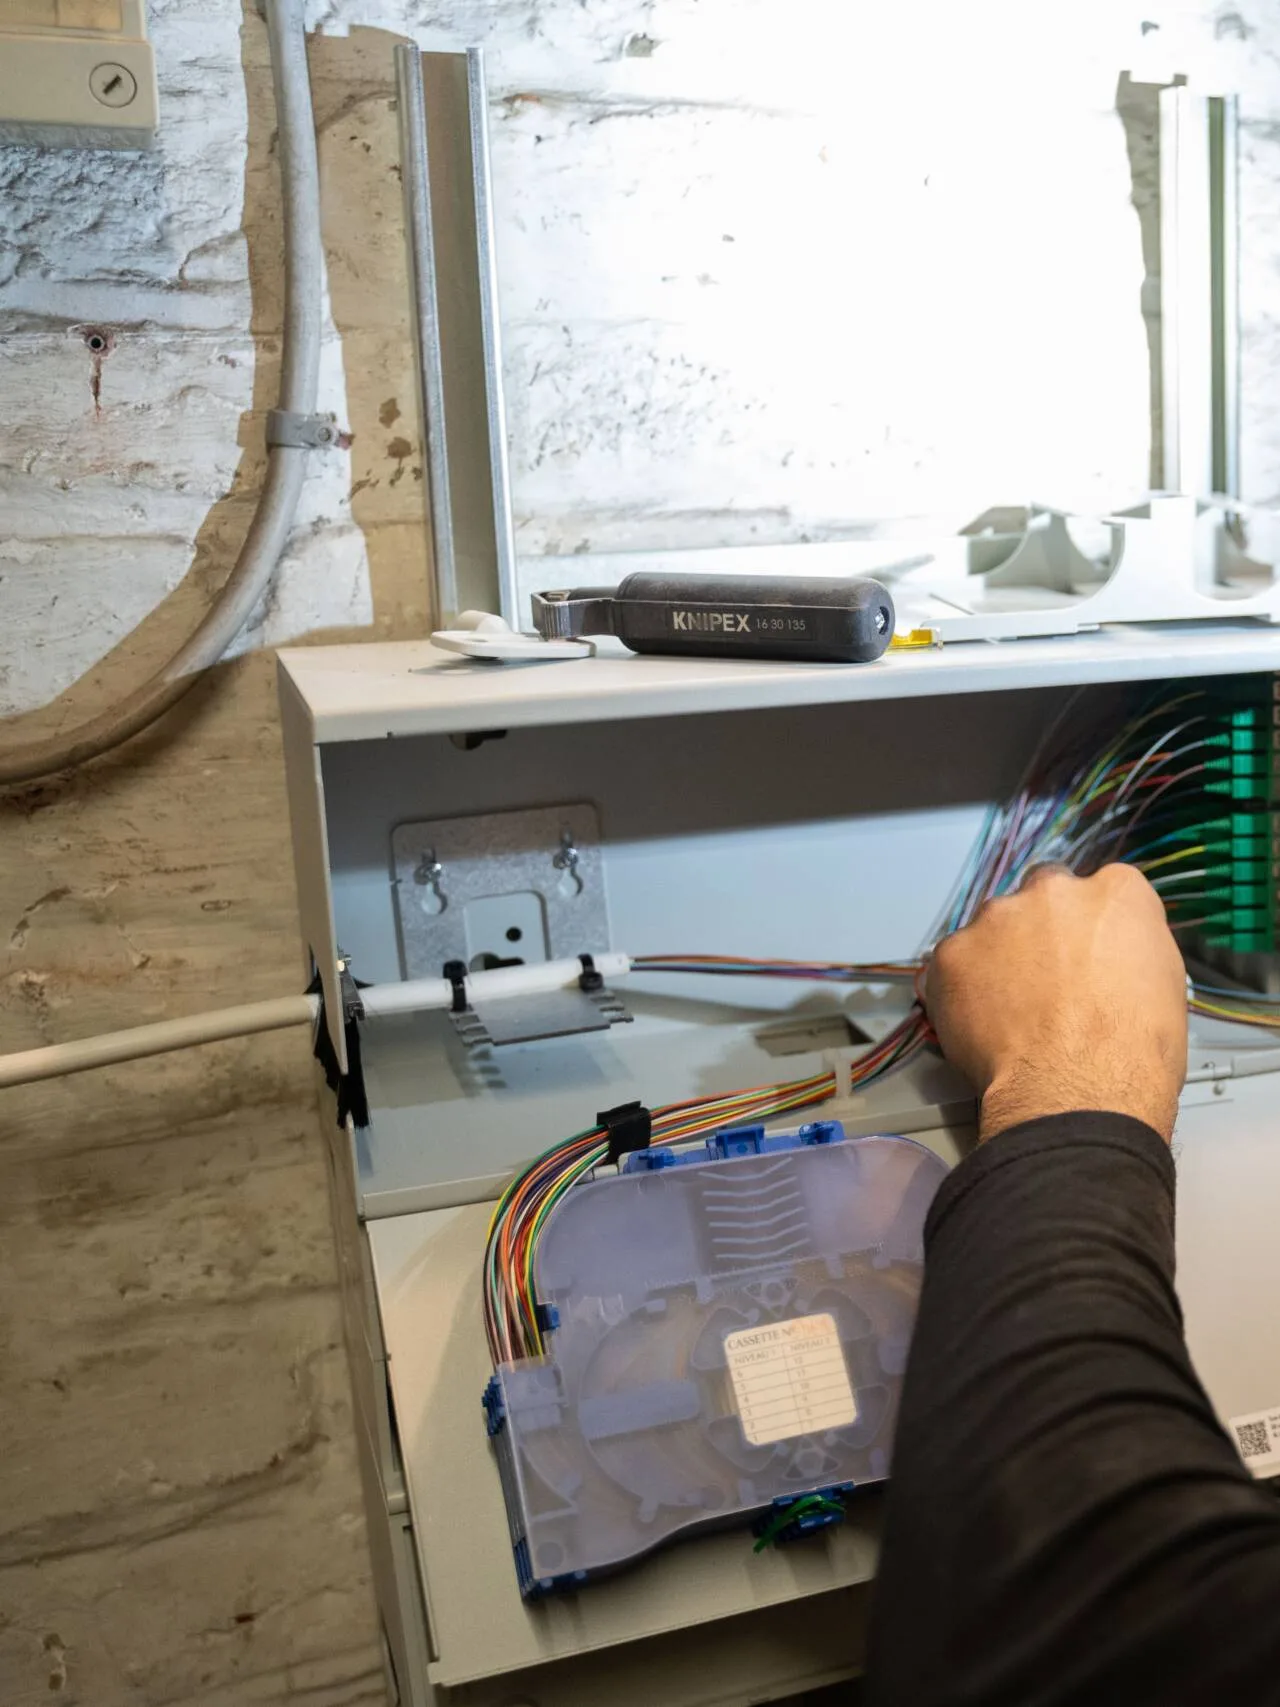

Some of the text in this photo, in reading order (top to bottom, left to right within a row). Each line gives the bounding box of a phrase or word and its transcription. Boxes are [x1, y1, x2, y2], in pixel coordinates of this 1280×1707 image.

[672, 611, 751, 632] KNIPEX
[770, 619, 783, 630] 30
[787, 619, 806, 631] 135
[728, 1329, 780, 1351] CASSETTE
